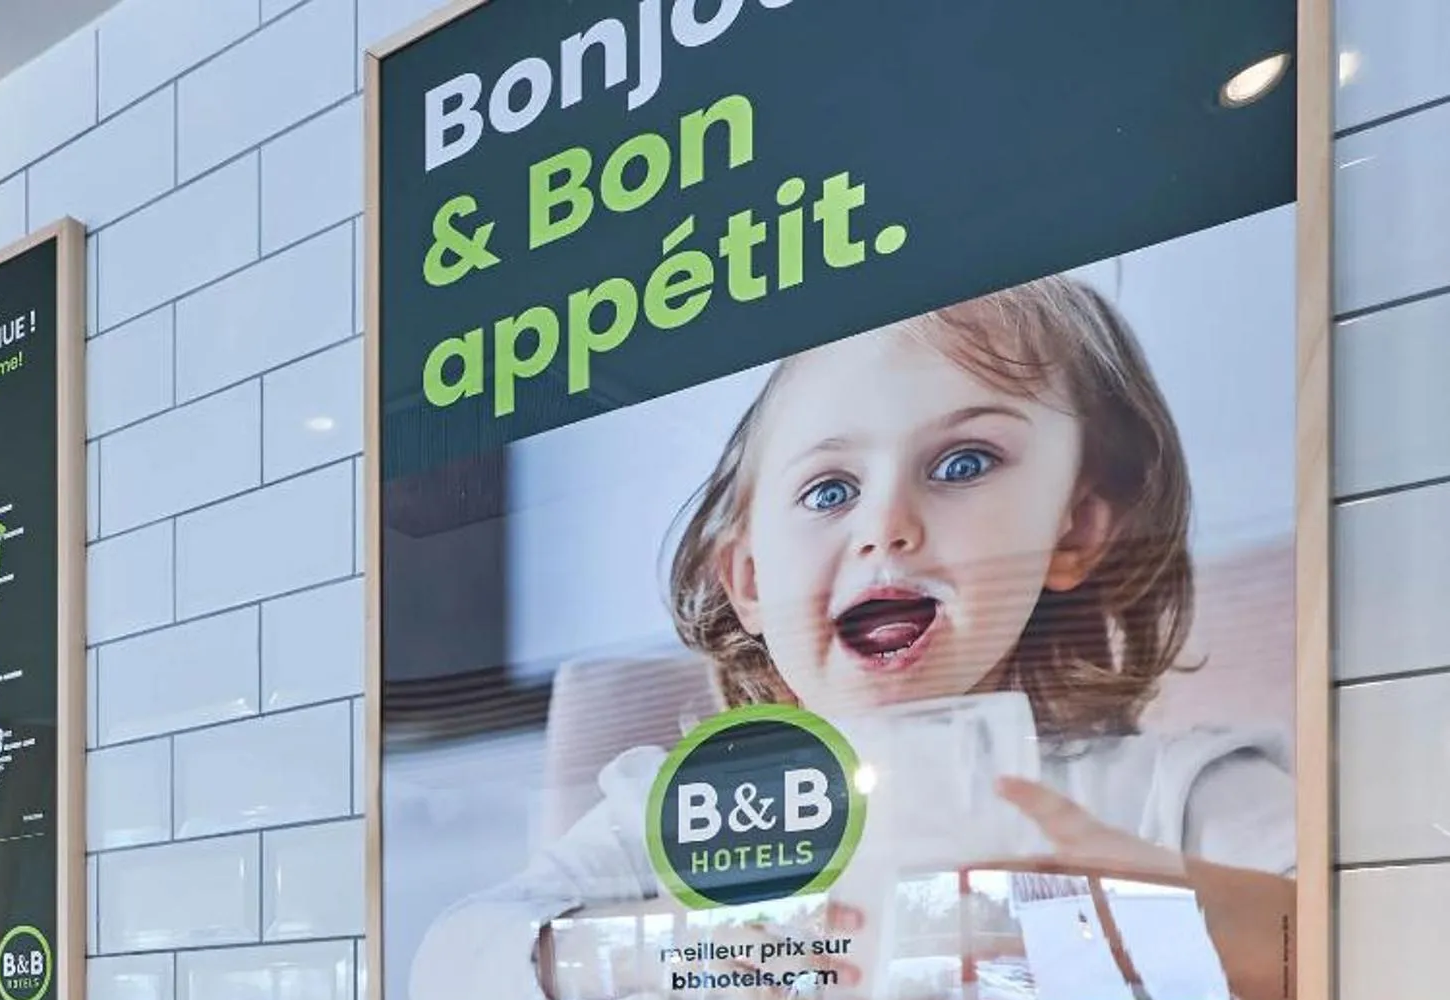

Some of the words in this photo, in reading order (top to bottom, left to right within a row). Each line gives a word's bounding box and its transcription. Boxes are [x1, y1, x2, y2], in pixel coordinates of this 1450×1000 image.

[425, 0, 793, 172] Bonjo
[423, 195, 501, 287] &
[529, 94, 753, 250] Bon
[423, 171, 907, 418] appétit.
[678, 768, 832, 844] B&B
[691, 841, 814, 874] HOTELS
[3, 951, 43, 977] B&B
[760, 937, 805, 963] prix
[812, 938, 851, 955] sur
